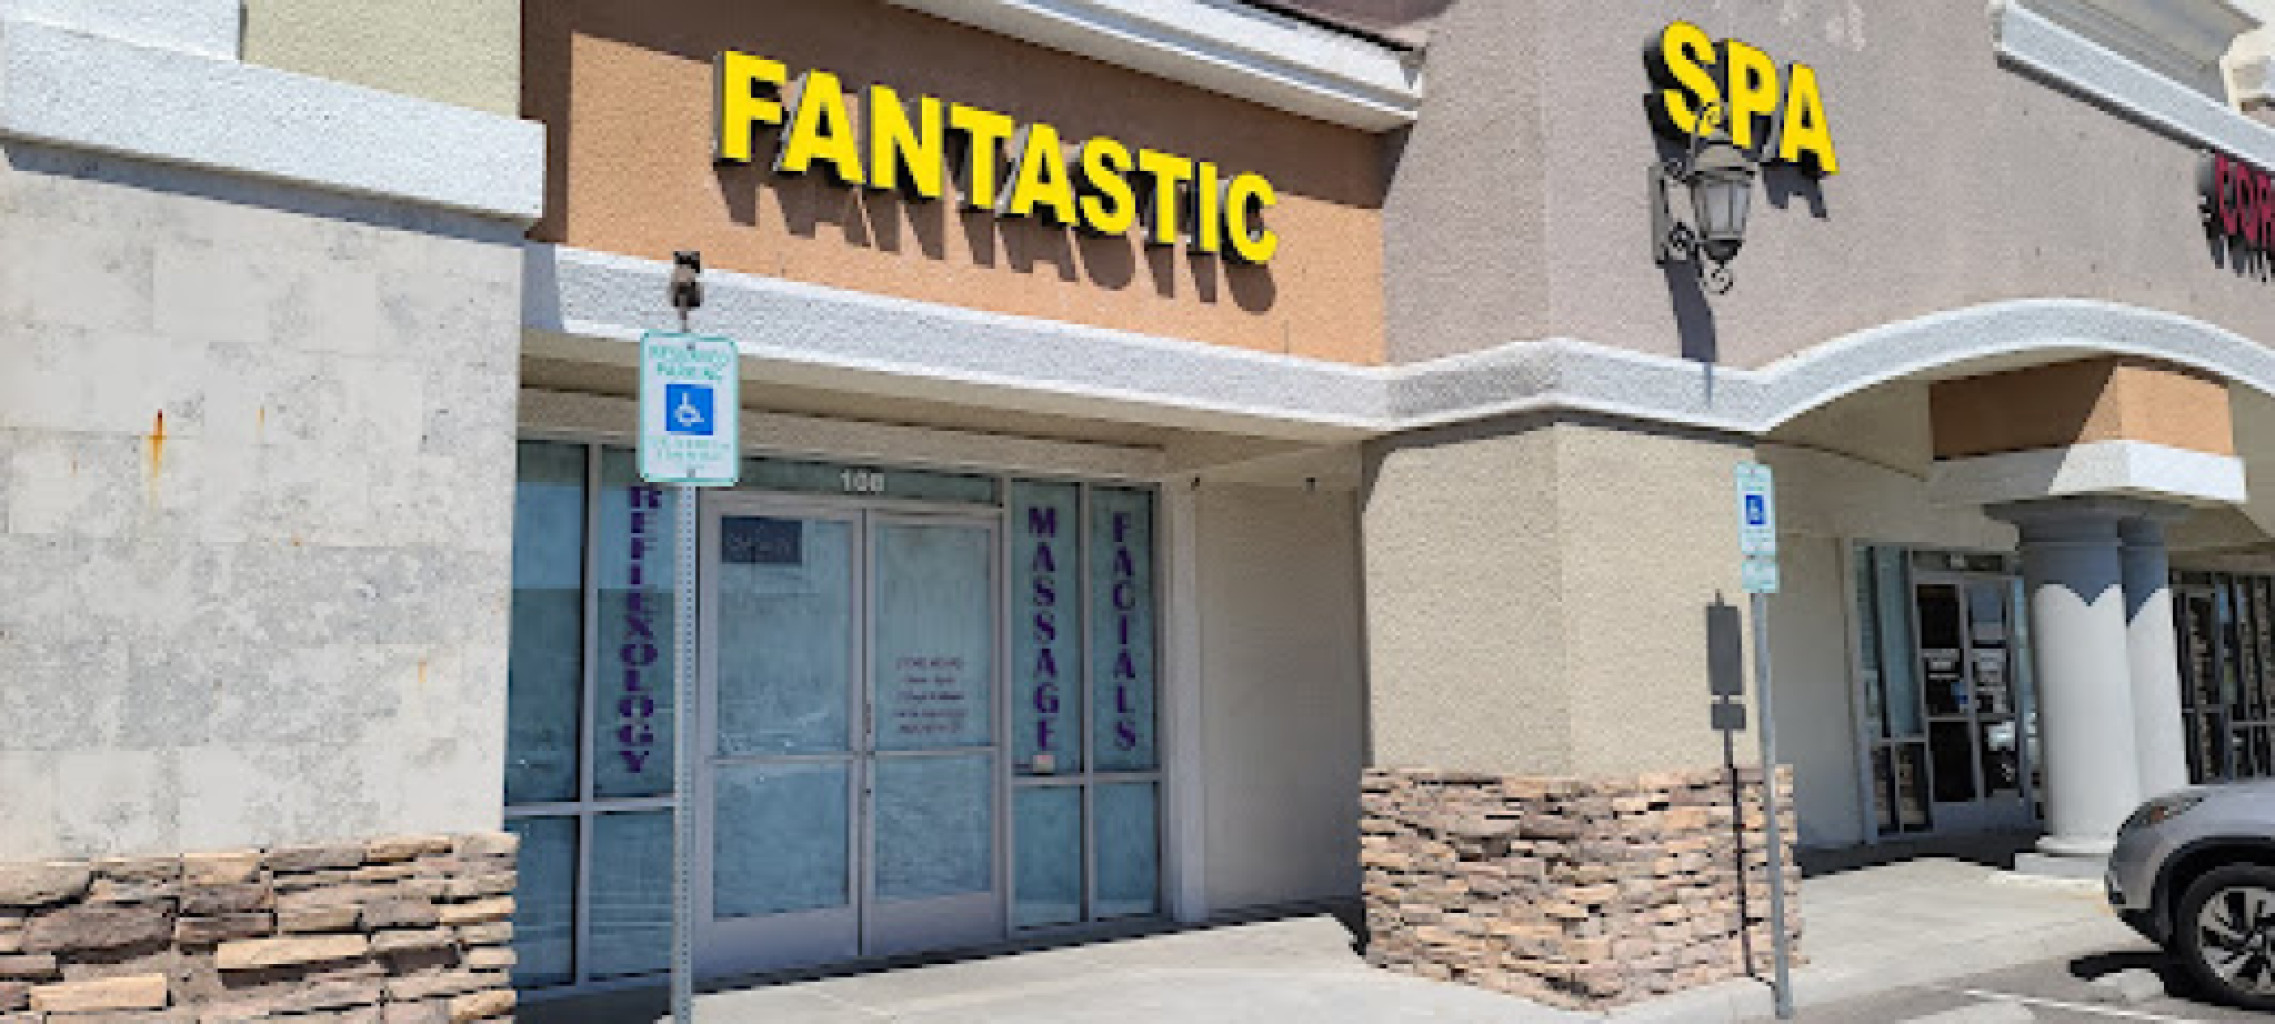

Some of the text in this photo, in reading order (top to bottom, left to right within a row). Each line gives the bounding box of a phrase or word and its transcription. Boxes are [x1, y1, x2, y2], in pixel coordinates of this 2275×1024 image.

[722, 50, 1280, 264] FANTASTIC
[1661, 20, 1840, 174] SPA
[616, 485, 663, 773] REFLEXOLOGY
[1027, 506, 1060, 751] MASSAGE
[1112, 510, 1136, 751] FACIALS
